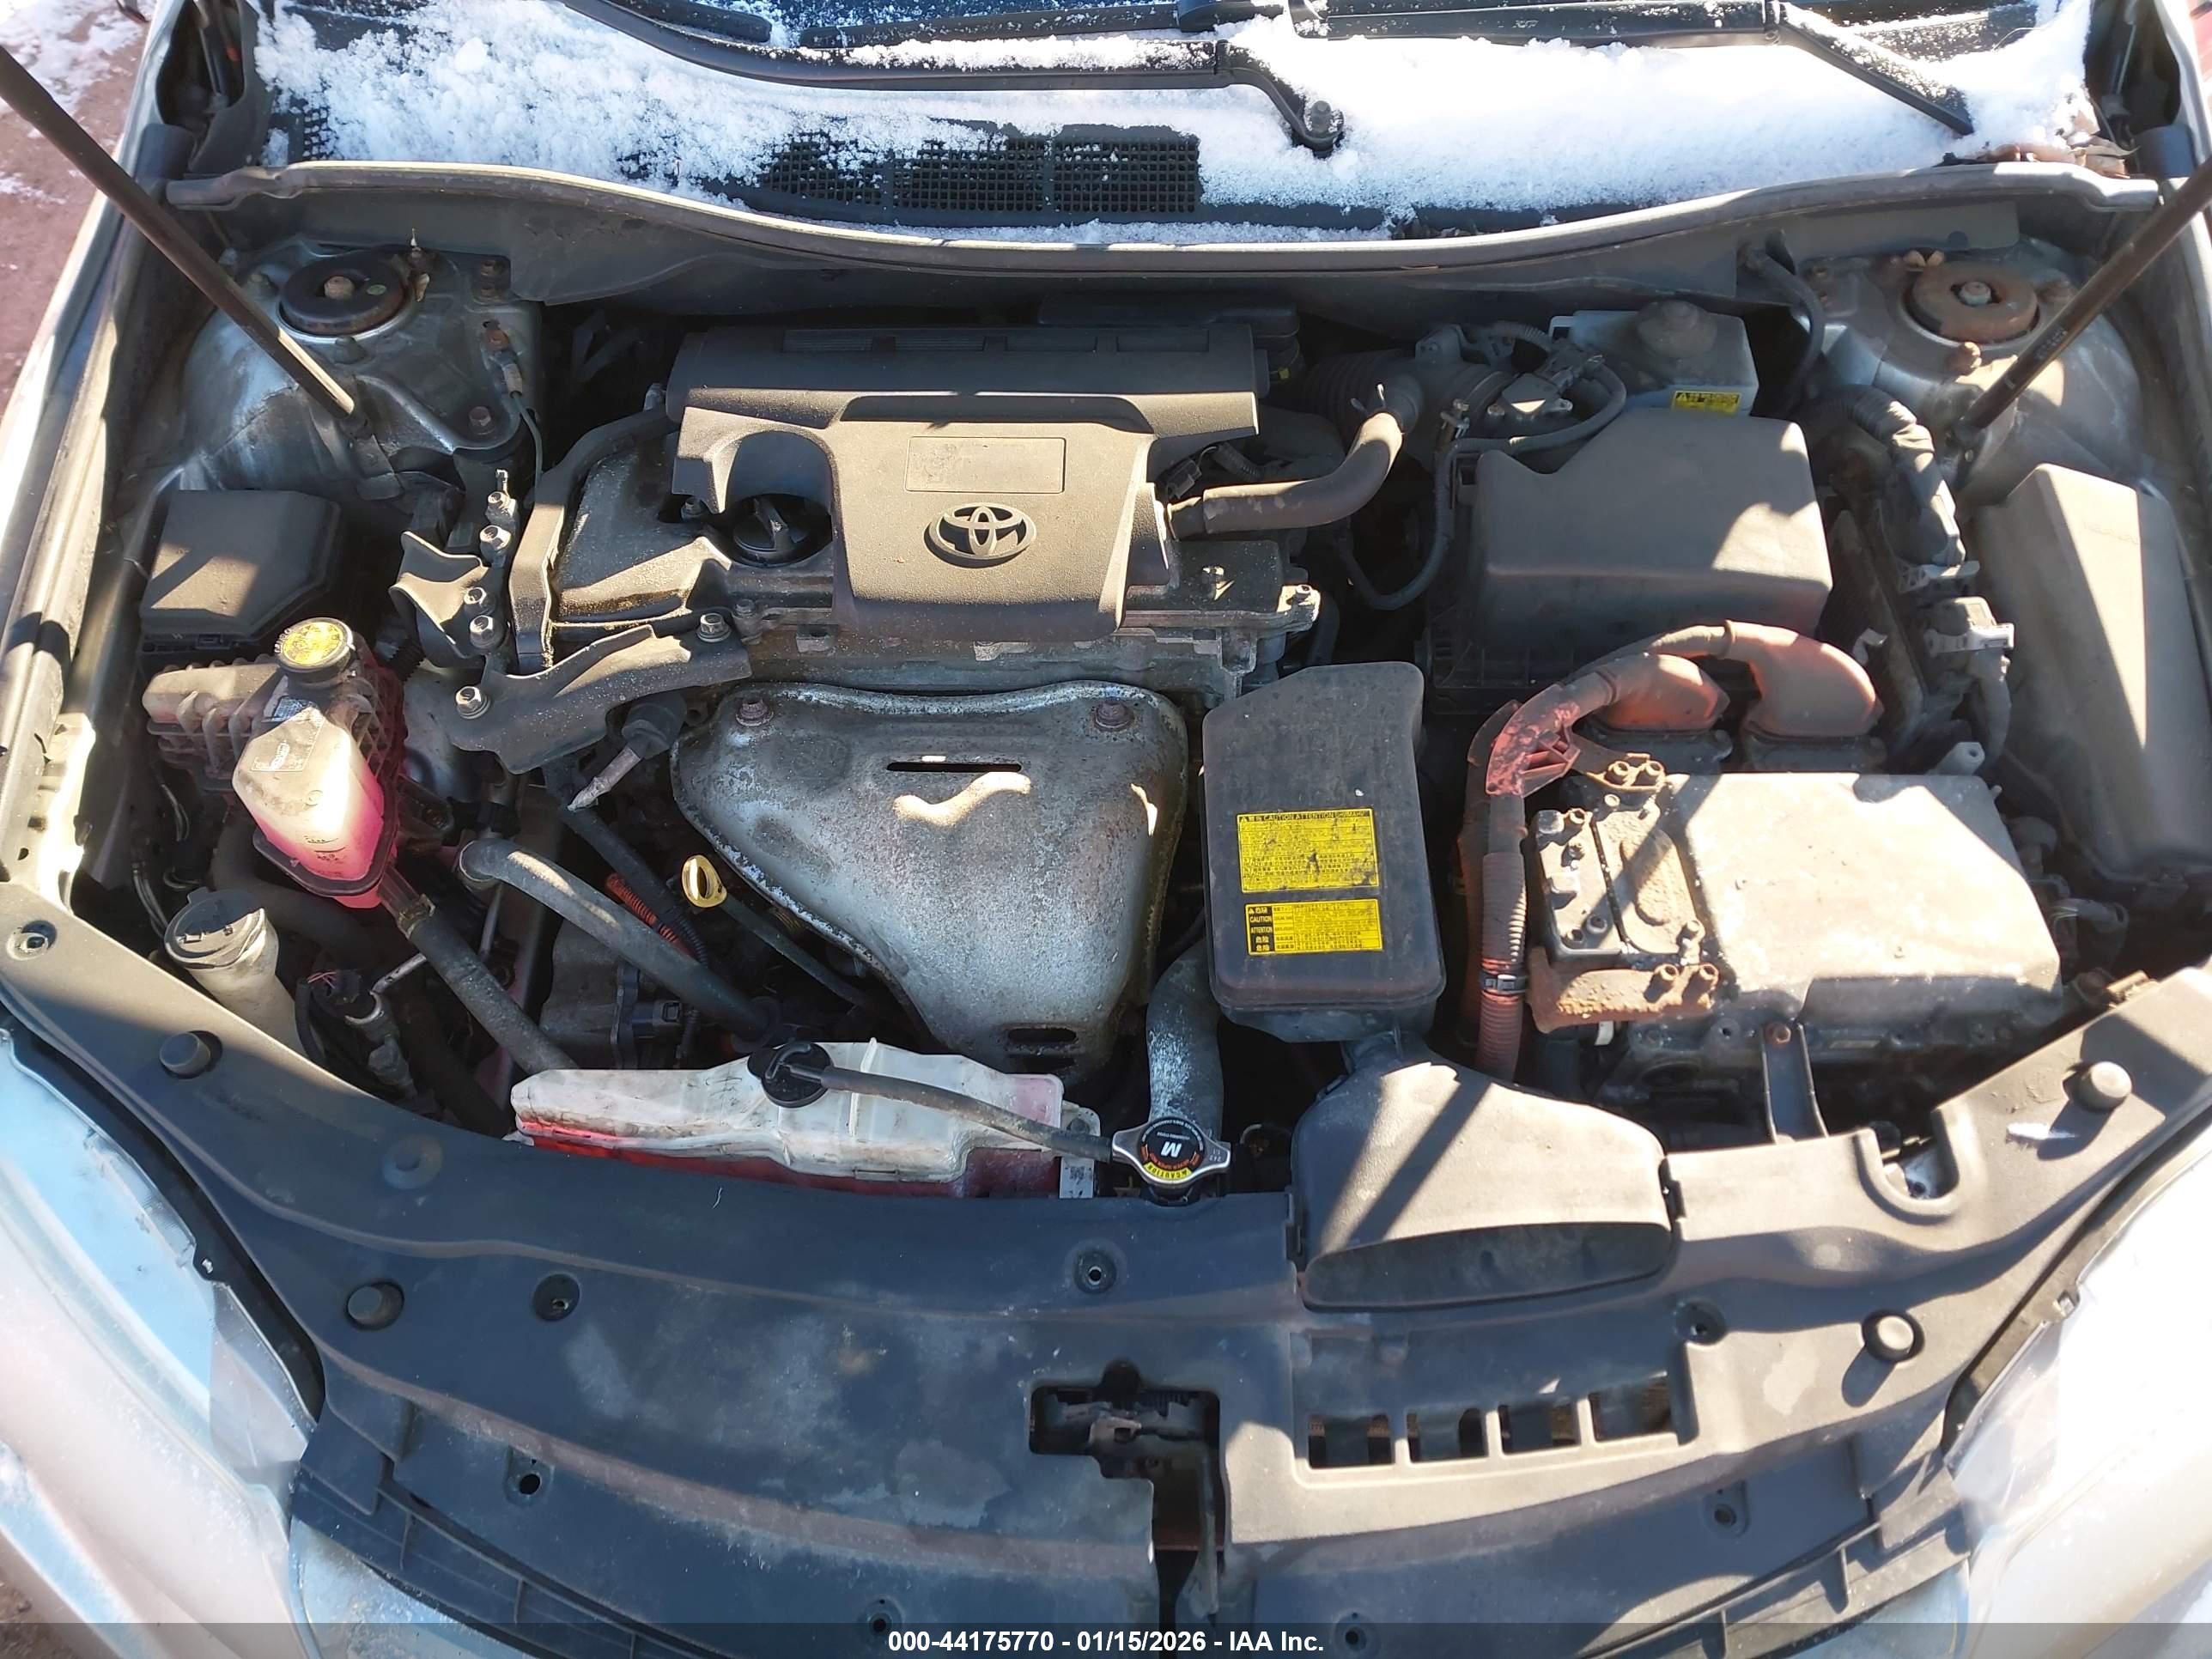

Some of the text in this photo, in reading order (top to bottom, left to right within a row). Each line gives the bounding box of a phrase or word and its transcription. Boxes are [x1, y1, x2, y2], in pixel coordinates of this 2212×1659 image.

[1263, 812, 1291, 821] CAUTION
[1296, 811, 1334, 820] ATTENTION
[1160, 1141, 1182, 1158] M
[1147, 1164, 1181, 1179] CAUTION
